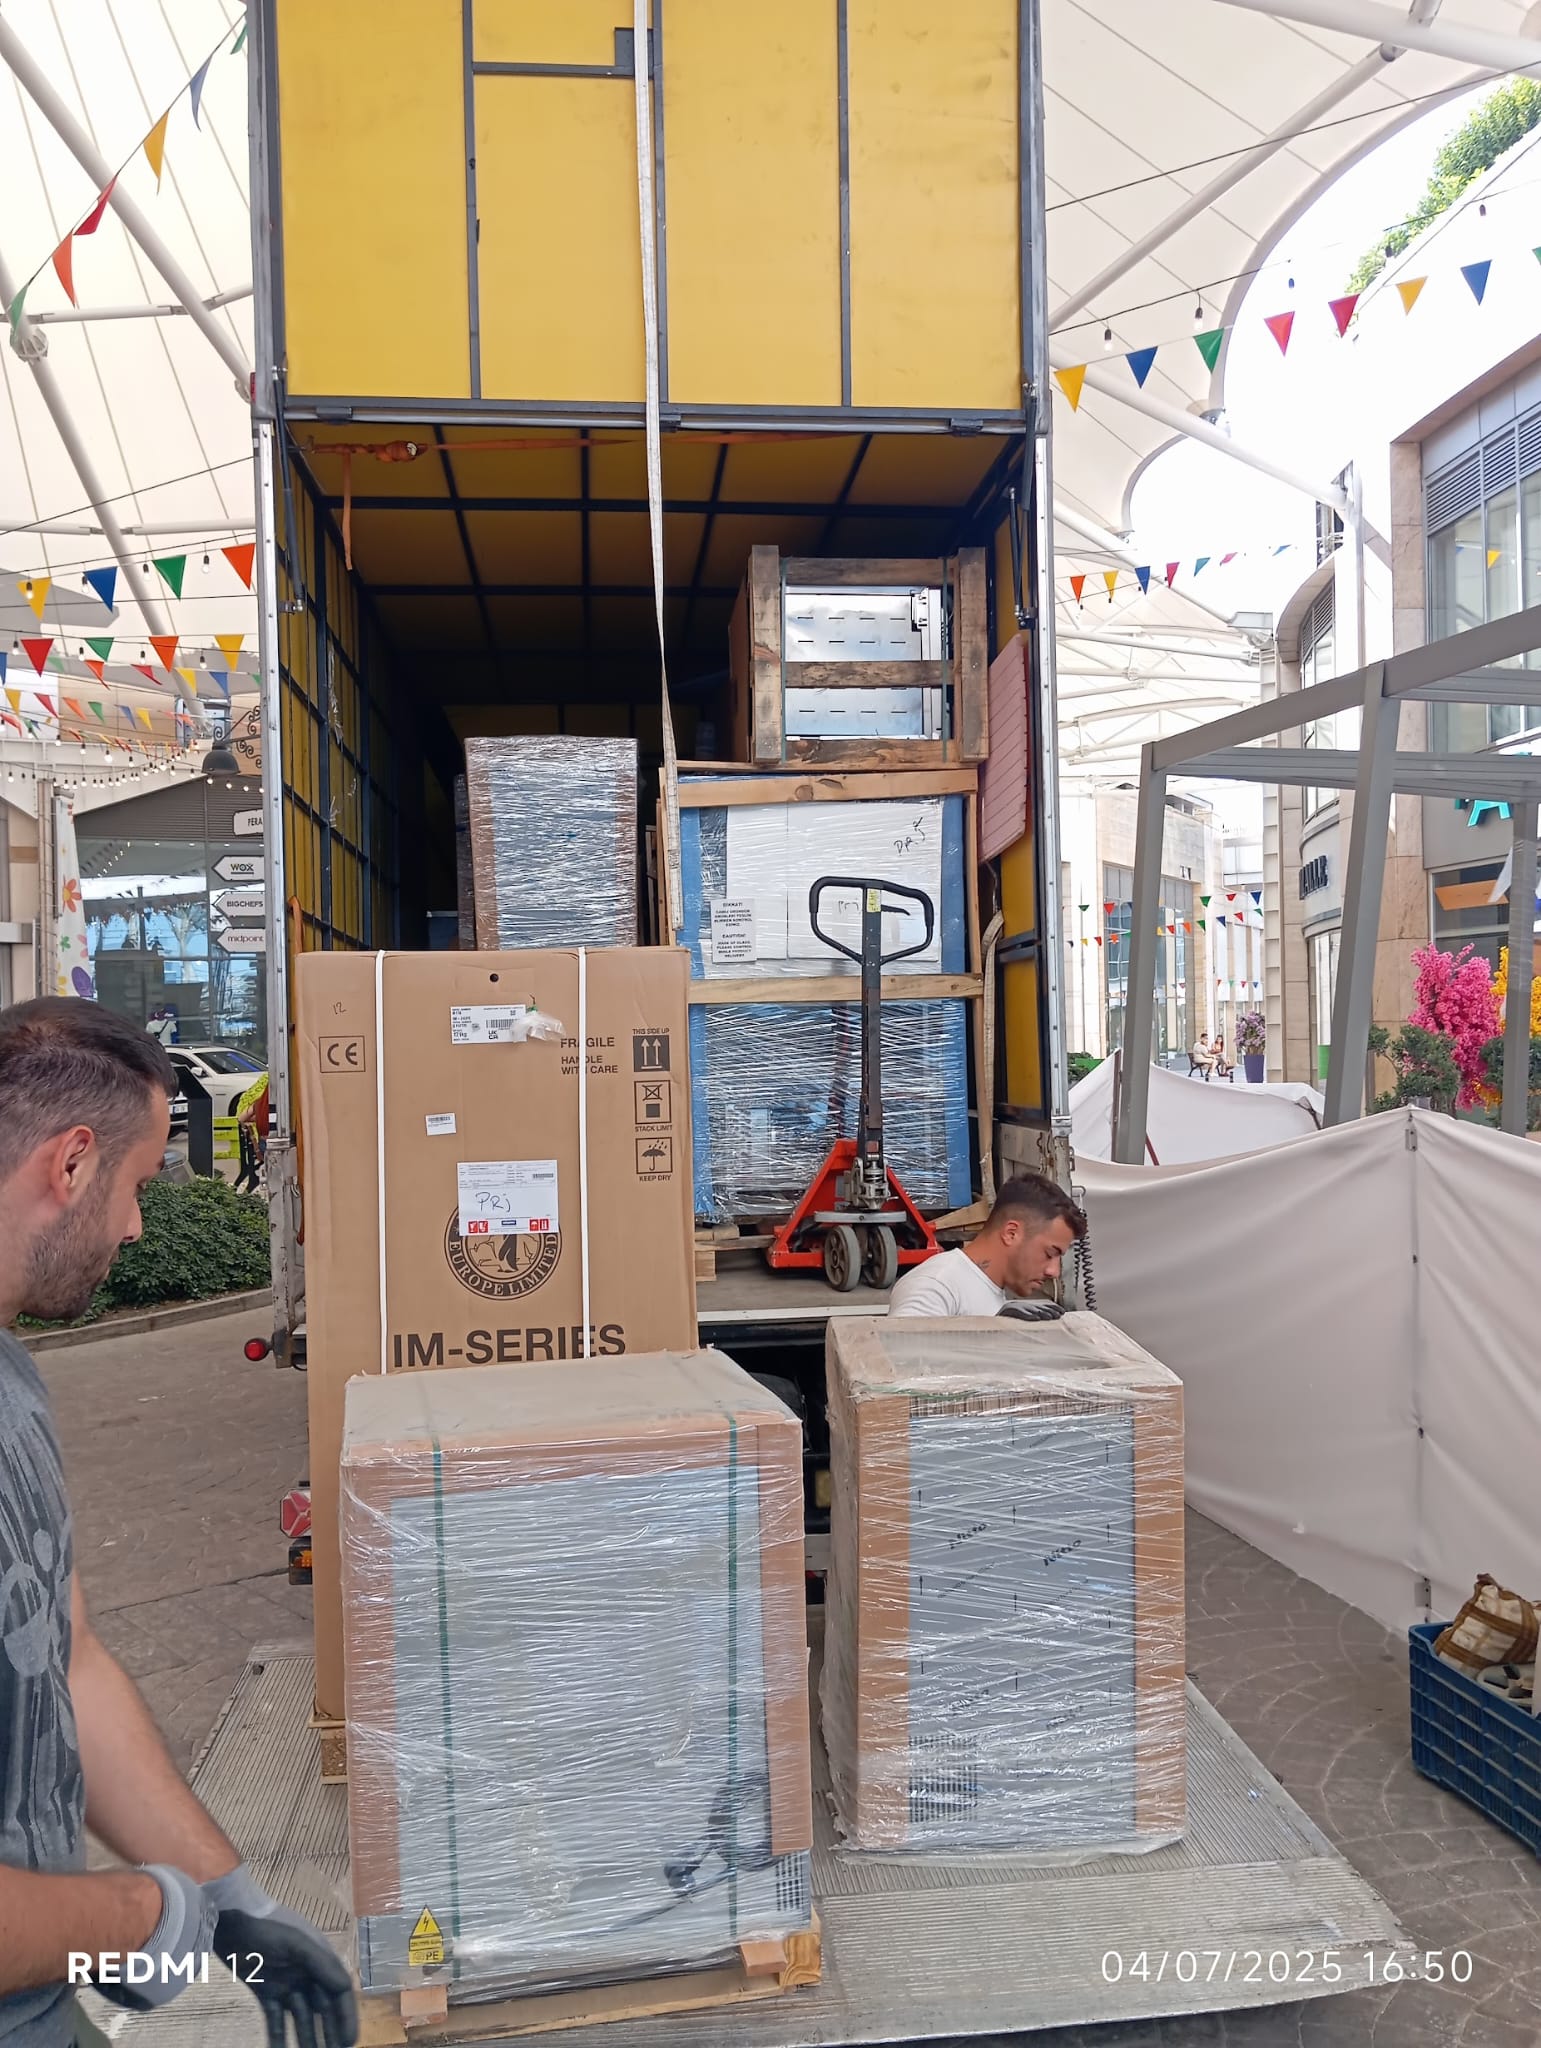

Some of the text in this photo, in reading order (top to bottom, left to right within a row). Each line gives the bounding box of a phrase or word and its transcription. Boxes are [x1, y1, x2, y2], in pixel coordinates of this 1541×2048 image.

[230, 863, 254, 872] WOX
[226, 900, 264, 908] BIGCHEFS
[227, 934, 264, 944] midpoint
[560, 1037, 615, 1049] FRGILE
[561, 1065, 619, 1075] WIT CARE
[449, 1234, 558, 1296] EUROPE LIMITED
[393, 1324, 626, 1368] IM-SERIES
